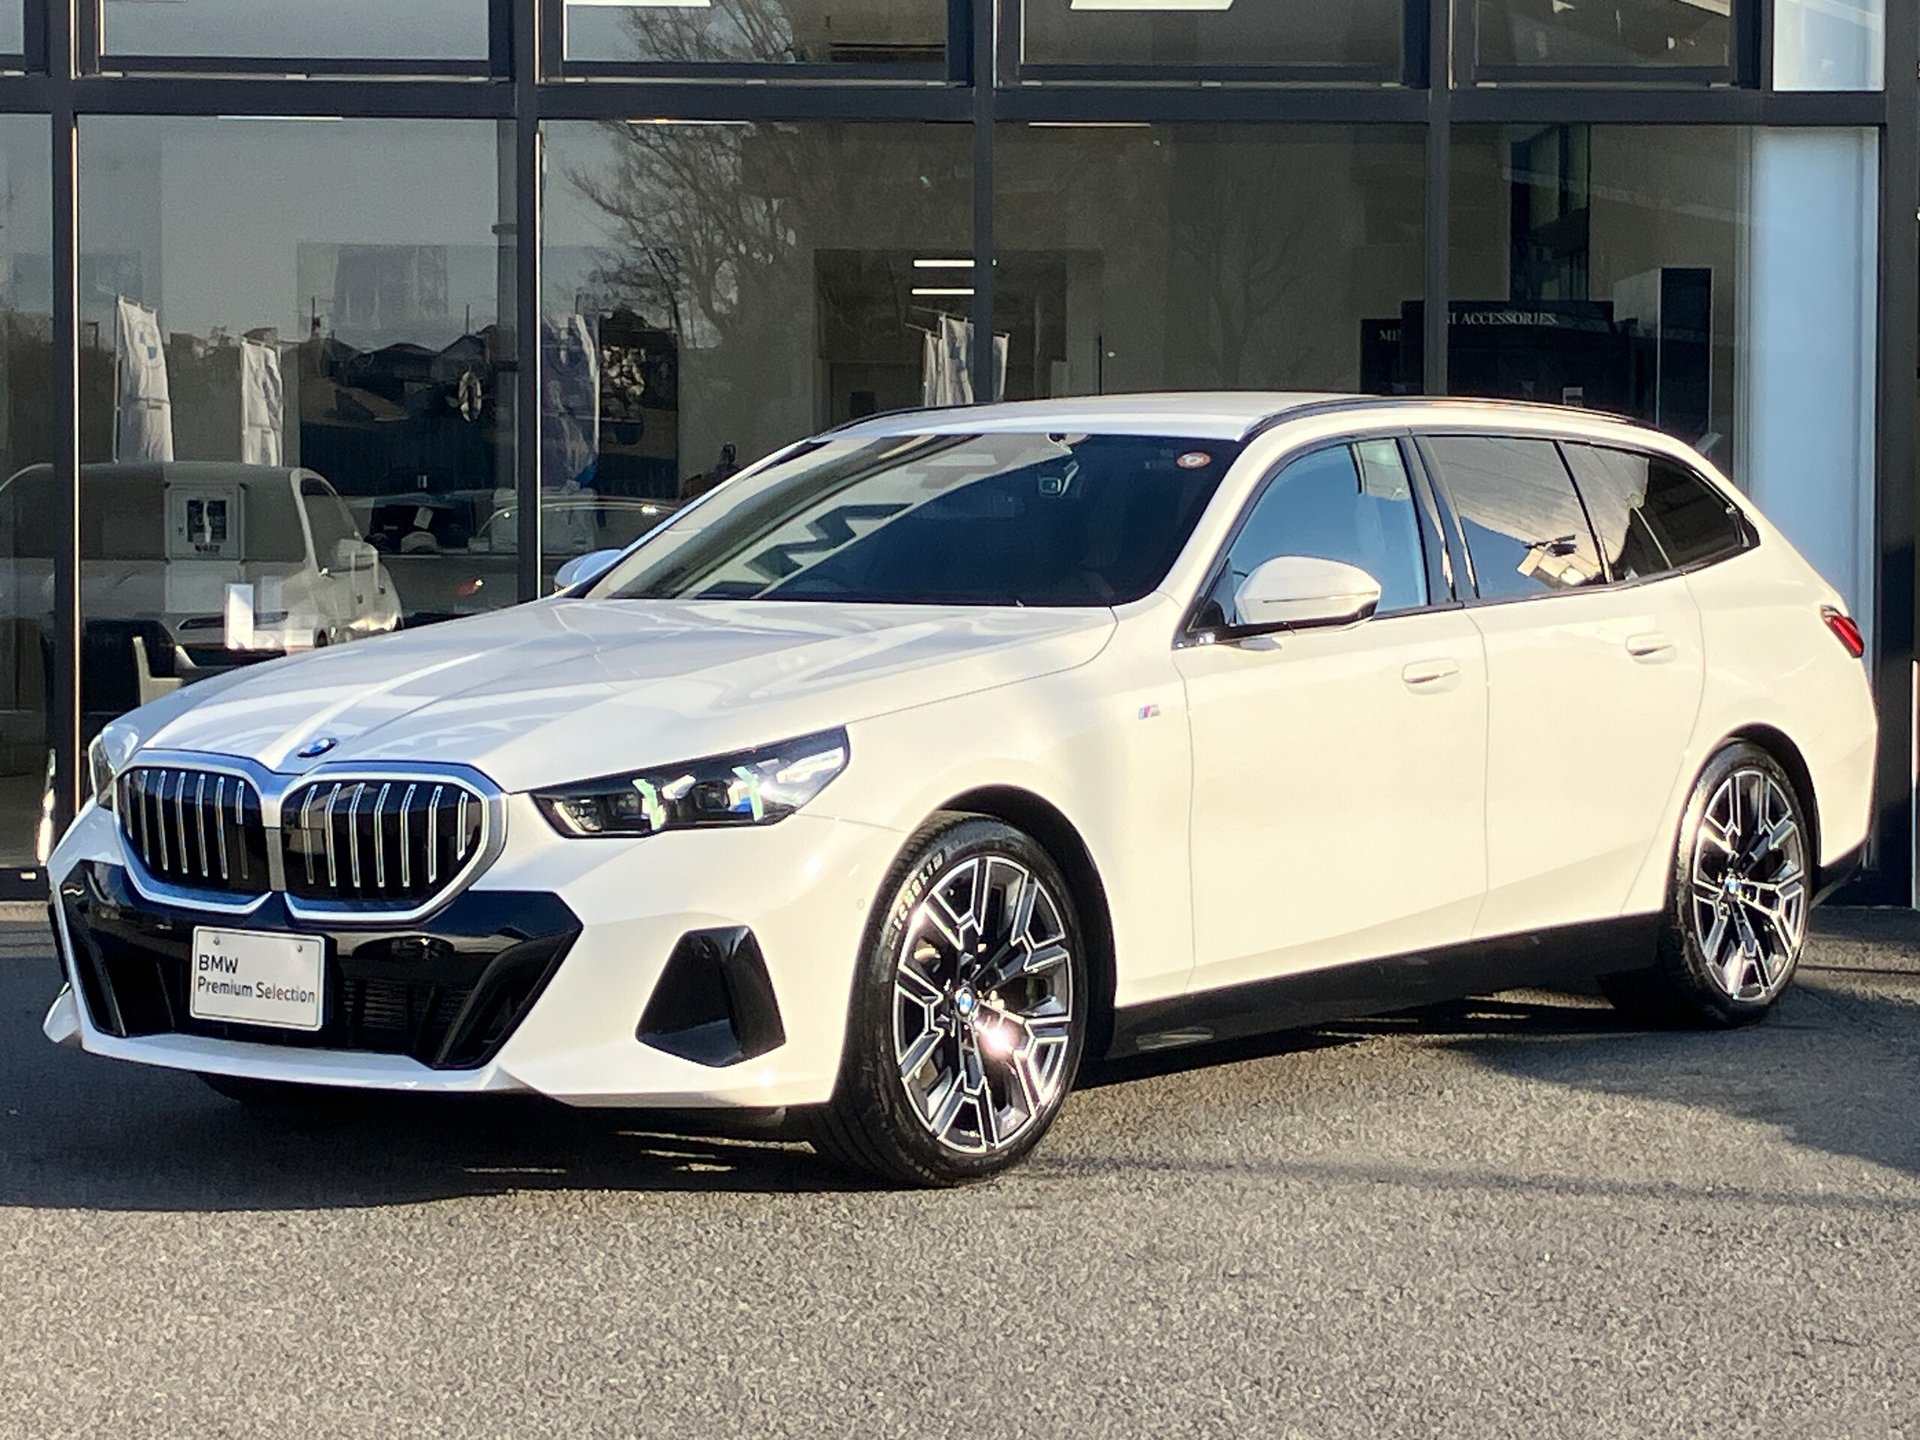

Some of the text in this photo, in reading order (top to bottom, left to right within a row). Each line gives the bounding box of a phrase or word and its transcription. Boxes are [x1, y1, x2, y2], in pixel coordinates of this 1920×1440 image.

[1460, 312, 1559, 326] ACCESSORIES
[199, 954, 238, 973] BMW
[197, 976, 315, 1003] Premium Selection
